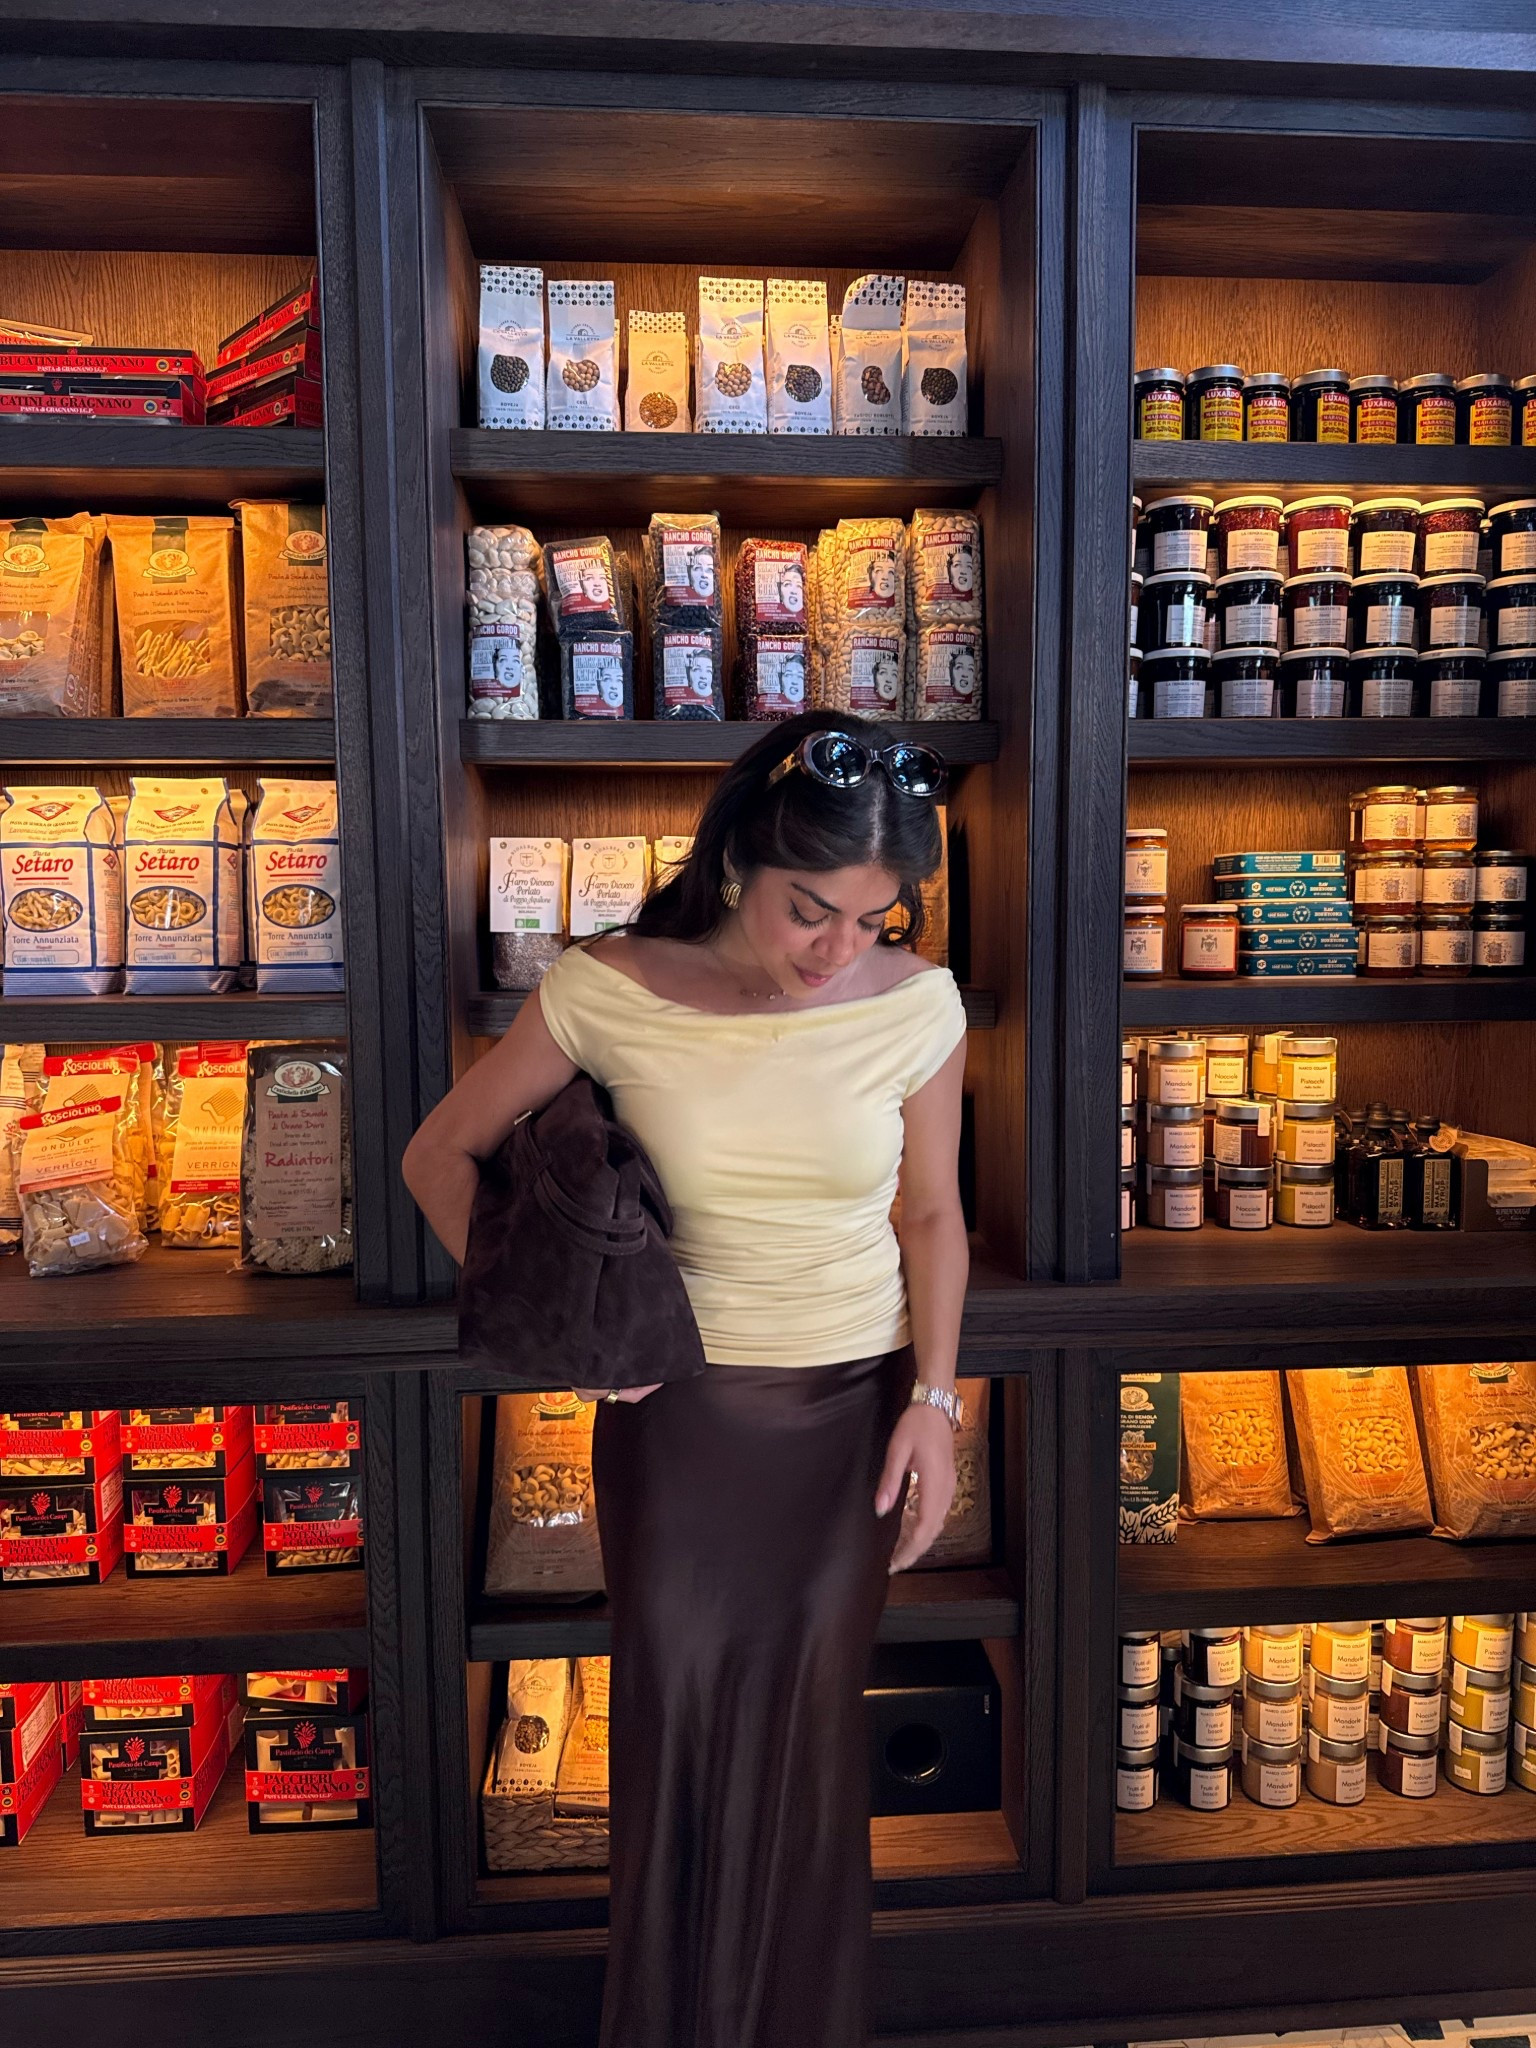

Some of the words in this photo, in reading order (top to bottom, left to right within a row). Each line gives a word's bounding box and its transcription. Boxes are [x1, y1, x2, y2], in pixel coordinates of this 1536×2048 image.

[0, 357, 59, 366] BUCATINI
[62, 356, 72, 366] di
[75, 357, 145, 368] GRAGNANO
[1147, 394, 1180, 402] LUXARDO
[1207, 391, 1240, 399] LUXARDO
[46, 396, 57, 406] di
[60, 397, 132, 409] GRAGNANO
[1253, 400, 1286, 408] LUXARDO
[1363, 400, 1396, 409] LUXARDO
[1424, 400, 1455, 409] LUXARDO
[1477, 400, 1510, 408] LUXARDO
[664, 532, 689, 542] RANCHO
[691, 532, 712, 542] GORDO
[925, 533, 949, 545] RANCHO
[951, 533, 971, 543] GORDO
[849, 539, 871, 551] RANCHO
[873, 538, 893, 548] GORDO
[756, 550, 780, 559] RANCHO
[781, 550, 801, 560] GORDO
[664, 635, 689, 645] RANCHO
[691, 635, 711, 646] GORDO
[931, 633, 954, 643] RANCHO
[955, 633, 975, 643] GORDO
[573, 643, 599, 653] RANCHO
[600, 643, 622, 654] GORDO
[757, 641, 782, 650] RANCHO
[783, 641, 803, 651] GORDO
[853, 638, 877, 649] RANCHO
[878, 639, 898, 650] GORDO
[12, 854, 74, 875] Setaro
[135, 851, 200, 873] Setaro
[266, 851, 328, 871] Setaro
[498, 869, 528, 894] Farro
[530, 877, 555, 887] Dicocco
[578, 872, 609, 897] Farro
[611, 880, 634, 890] Dicocco
[516, 886, 541, 896] Perlato
[596, 889, 621, 899] Perlato
[510, 896, 528, 905] Poggio
[528, 896, 551, 905] Aquilone
[590, 899, 607, 908] Poggio
[608, 900, 631, 908] Aquilone
[12, 936, 31, 944] Torre
[33, 935, 79, 944] Annunziata
[134, 934, 153, 942] Torre
[155, 934, 202, 942] Annunziata
[268, 932, 285, 940] Torre
[287, 932, 333, 940] Annunziata
[41, 1104, 102, 1127] ROSCIOLINO
[268, 1110, 289, 1119] Pasta
[271, 1122, 278, 1130] di
[281, 1122, 303, 1131] Grano
[305, 1121, 325, 1129] Duro
[264, 1152, 334, 1167] Radiatori
[36, 1158, 99, 1174] VERRIGNI
[1301, 1202, 1326, 1210] Pistacchi
[272, 1425, 331, 1434] MISCHIATO
[272, 1433, 320, 1441] POTENTE
[141, 1526, 200, 1534] MISCHIATO
[282, 1522, 341, 1531] MISCHIATO
[142, 1533, 189, 1541] POTENTE
[283, 1530, 331, 1539] POTENTE
[9, 1537, 69, 1547] MISCHIATO
[148, 1541, 203, 1549] GRAGNANO
[289, 1537, 345, 1546] GRAGNANO
[9, 1545, 58, 1555] POTENTE
[15, 1553, 73, 1562] GRAGNANO
[1419, 1650, 1441, 1658] Nocciole
[1334, 1717, 1361, 1725] Mandorle
[315, 1748, 335, 1756] Campi
[108, 1761, 133, 1769] Pastificio
[264, 1774, 334, 1785] PACCHERI
[1341, 1778, 1365, 1787] Mandorle
[102, 1782, 135, 1791] MEZZI
[272, 1782, 350, 1794] GRAGNANO
[102, 1789, 158, 1798] RIGATONI
[109, 1795, 173, 1805] GRAGNANO
